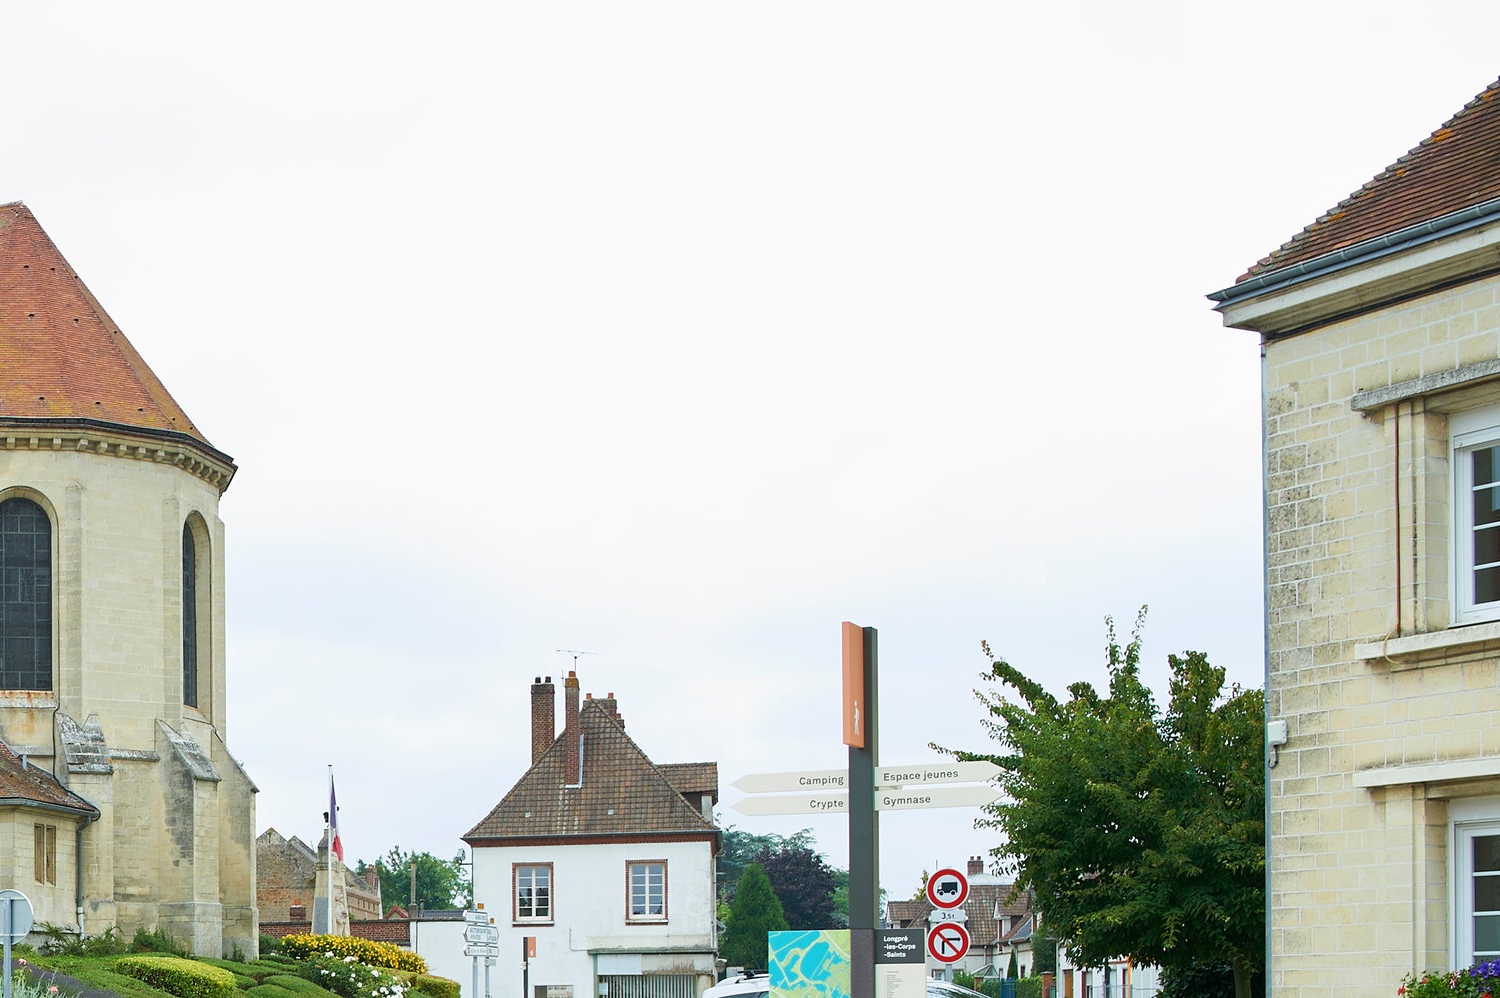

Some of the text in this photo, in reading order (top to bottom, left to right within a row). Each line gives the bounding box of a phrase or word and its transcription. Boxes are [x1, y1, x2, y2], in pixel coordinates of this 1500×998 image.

[883, 770, 959, 782] Espace jeunes
[799, 776, 844, 786] Camping
[809, 800, 844, 809] Crypte
[883, 796, 931, 806] Gymnase
[941, 912, 955, 920] 3,5t
[883, 935, 908, 943] Longpré
